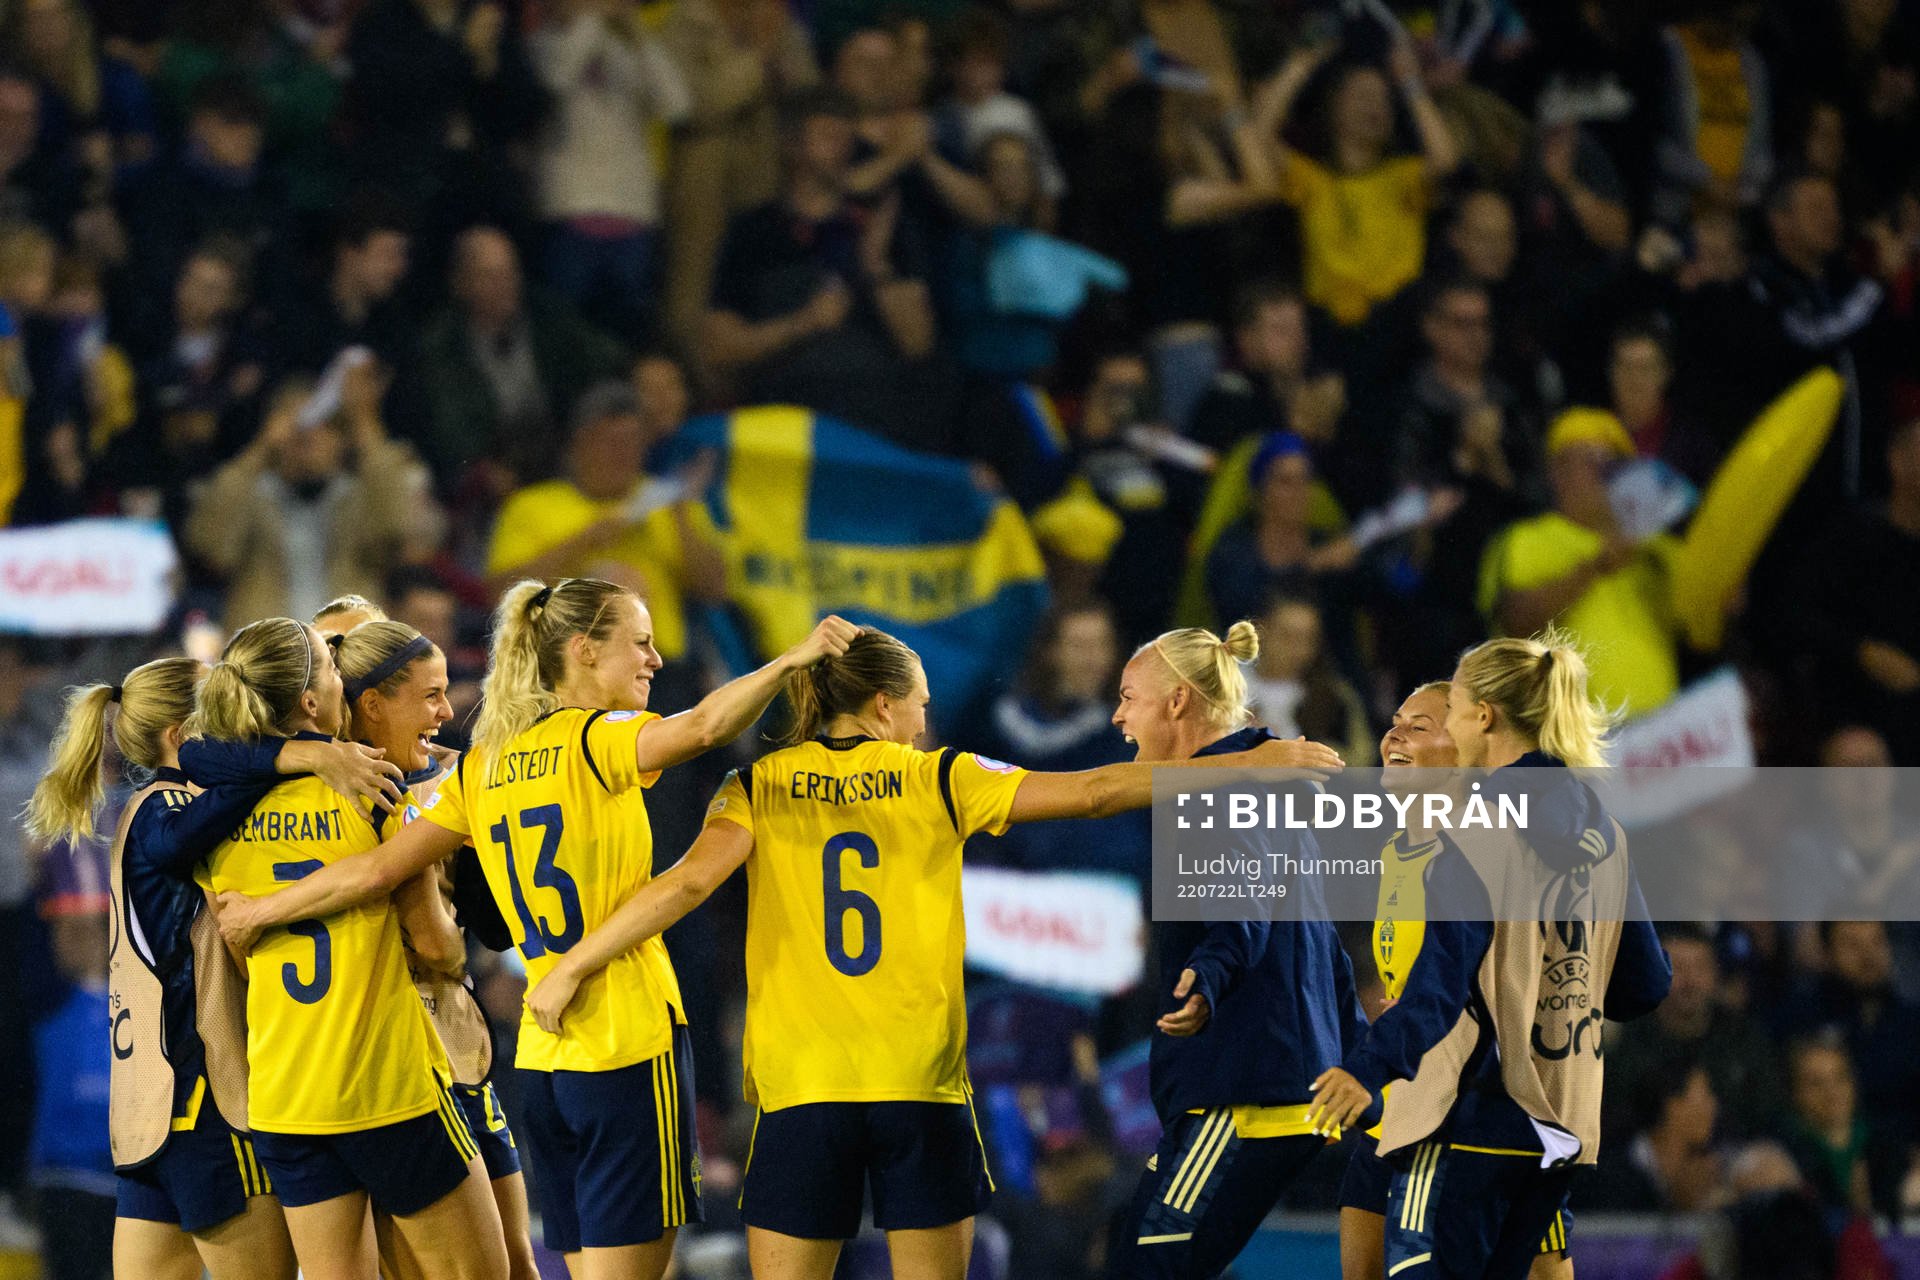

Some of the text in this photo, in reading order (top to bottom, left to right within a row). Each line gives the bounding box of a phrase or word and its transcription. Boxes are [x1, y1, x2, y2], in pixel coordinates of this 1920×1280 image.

[791, 768, 902, 806] ERIKSSON
[490, 803, 584, 960] 13
[822, 831, 882, 977] 6
